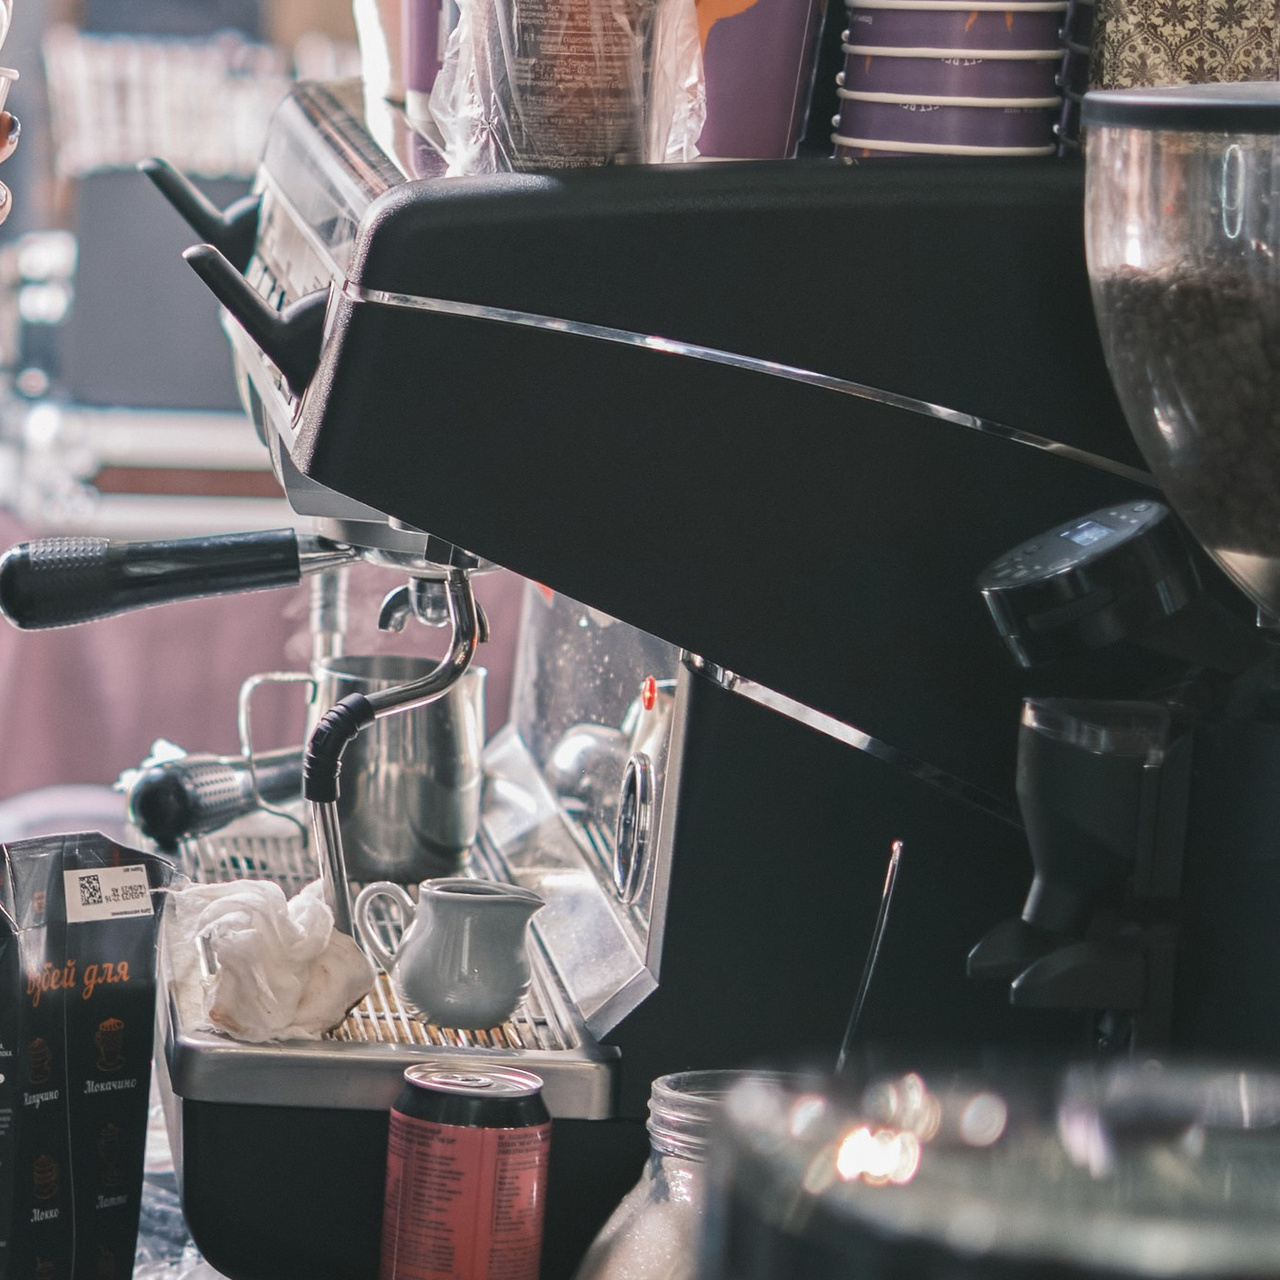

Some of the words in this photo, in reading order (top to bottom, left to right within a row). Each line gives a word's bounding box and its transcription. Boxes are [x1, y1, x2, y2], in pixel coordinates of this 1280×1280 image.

[82, 960, 130, 1001] для
[83, 1077, 138, 1094] Мокачино
[23, 1090, 60, 1109] Капучино
[30, 1208, 60, 1223] Мокко
